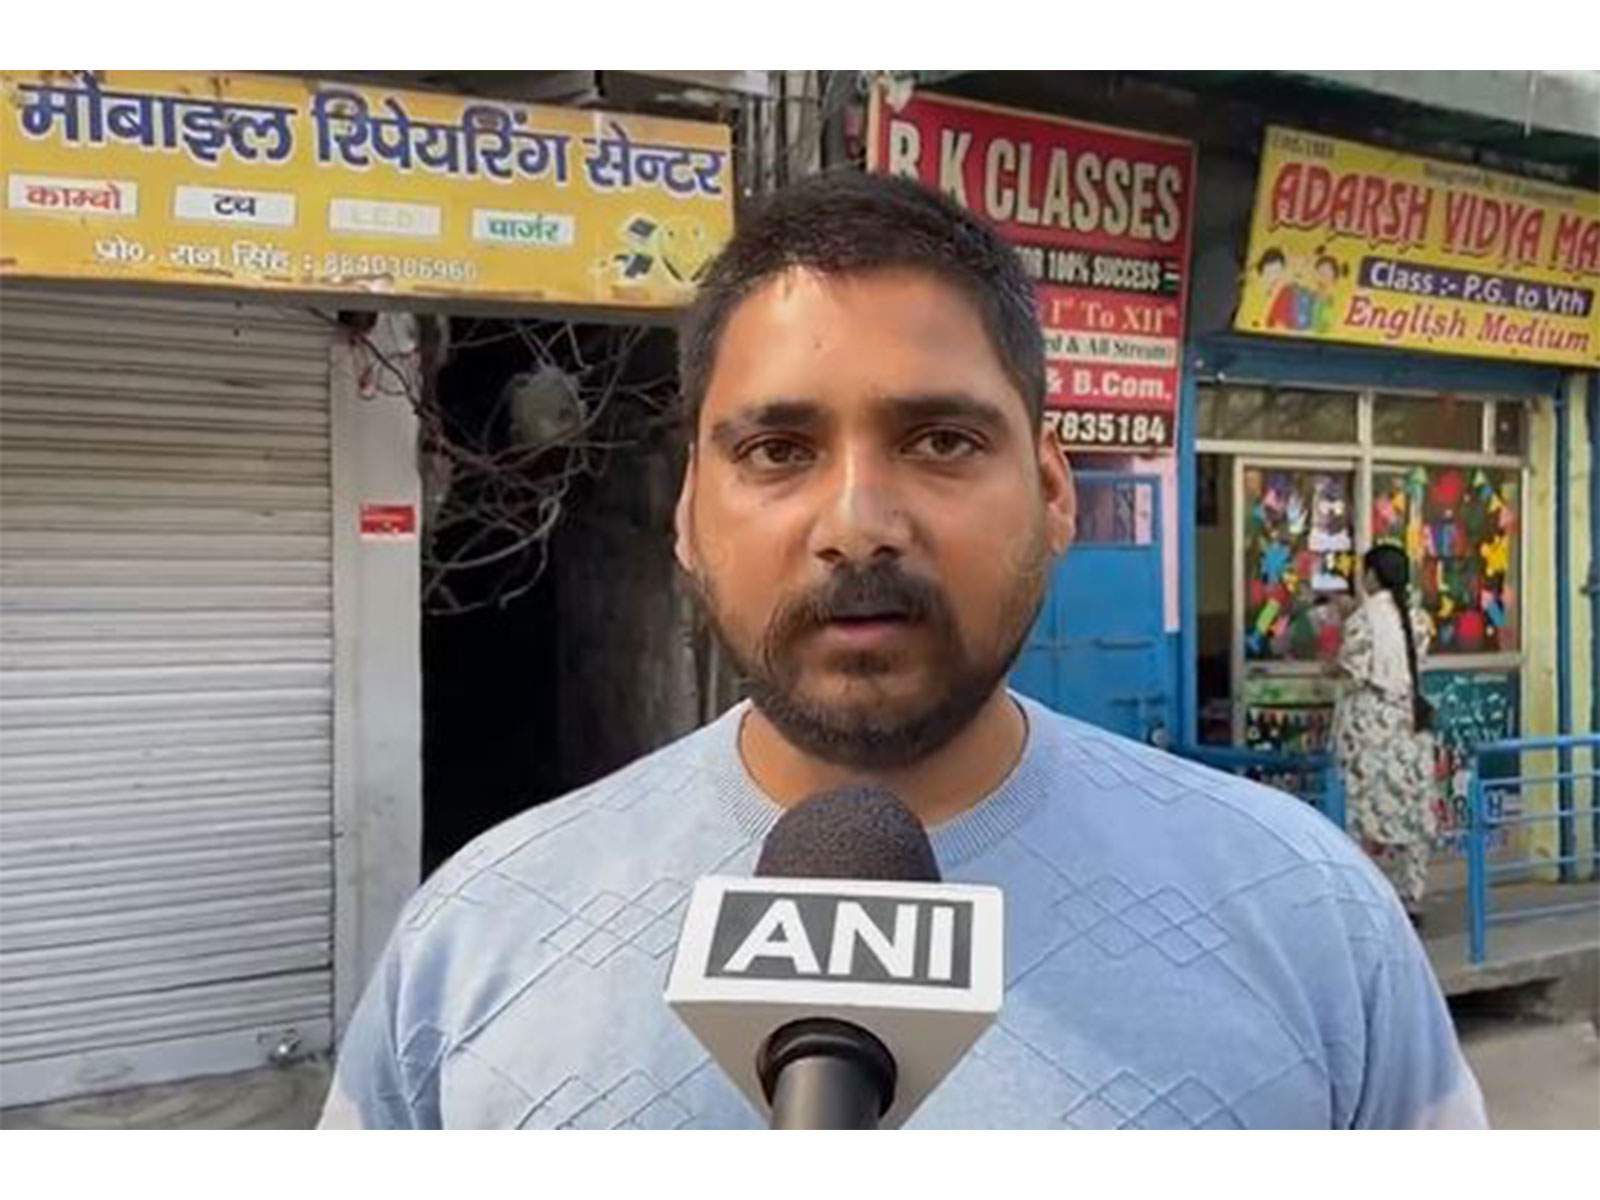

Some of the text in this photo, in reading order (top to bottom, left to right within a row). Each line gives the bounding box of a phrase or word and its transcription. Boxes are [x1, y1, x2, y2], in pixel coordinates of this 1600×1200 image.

[18, 70, 726, 194] मोबाइल रिपेयरिंग सेन्टर
[939, 129, 972, 208] K
[984, 138, 1181, 242] CLASSES
[1270, 162, 1433, 253] ADARSH
[1443, 191, 1545, 260] VIDYA
[1092, 255, 1161, 291] SUCCESS
[1369, 261, 1433, 295] Class
[1464, 273, 1507, 303] P.G.
[1514, 284, 1540, 310] to
[1546, 289, 1586, 317] Vth
[1080, 301, 1115, 328] To
[1343, 295, 1590, 351] English Medium
[1073, 370, 1172, 401] B.Com.
[721, 899, 954, 981] ANI
